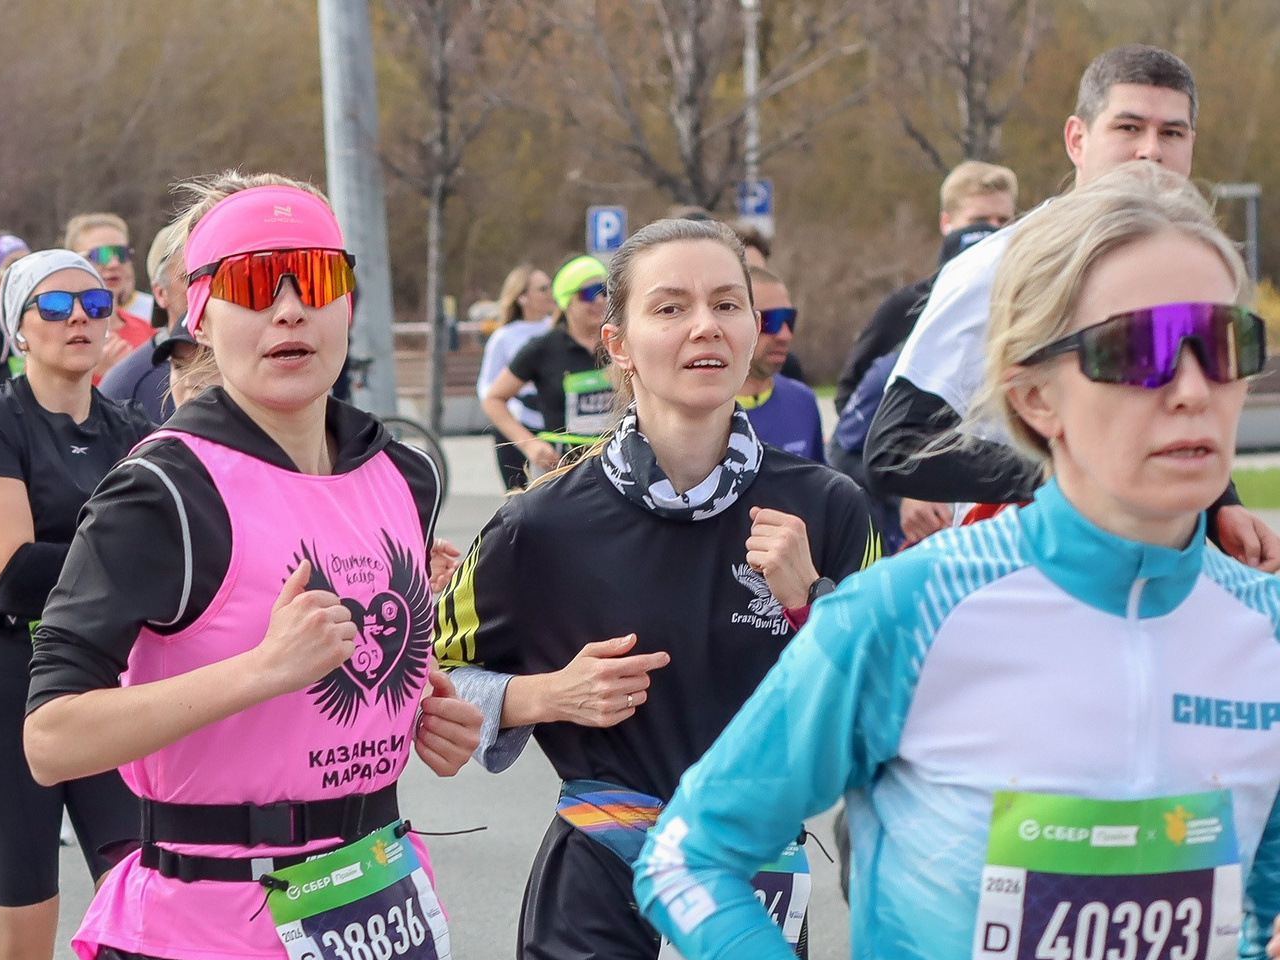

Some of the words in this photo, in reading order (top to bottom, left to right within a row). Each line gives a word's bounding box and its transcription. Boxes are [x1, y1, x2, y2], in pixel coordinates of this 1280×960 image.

[597, 211, 621, 249] P
[1173, 694, 1280, 730] СИБУР
[1043, 825, 1090, 842] СБЕР
[302, 878, 331, 895] СБЕР
[983, 922, 1010, 952] D
